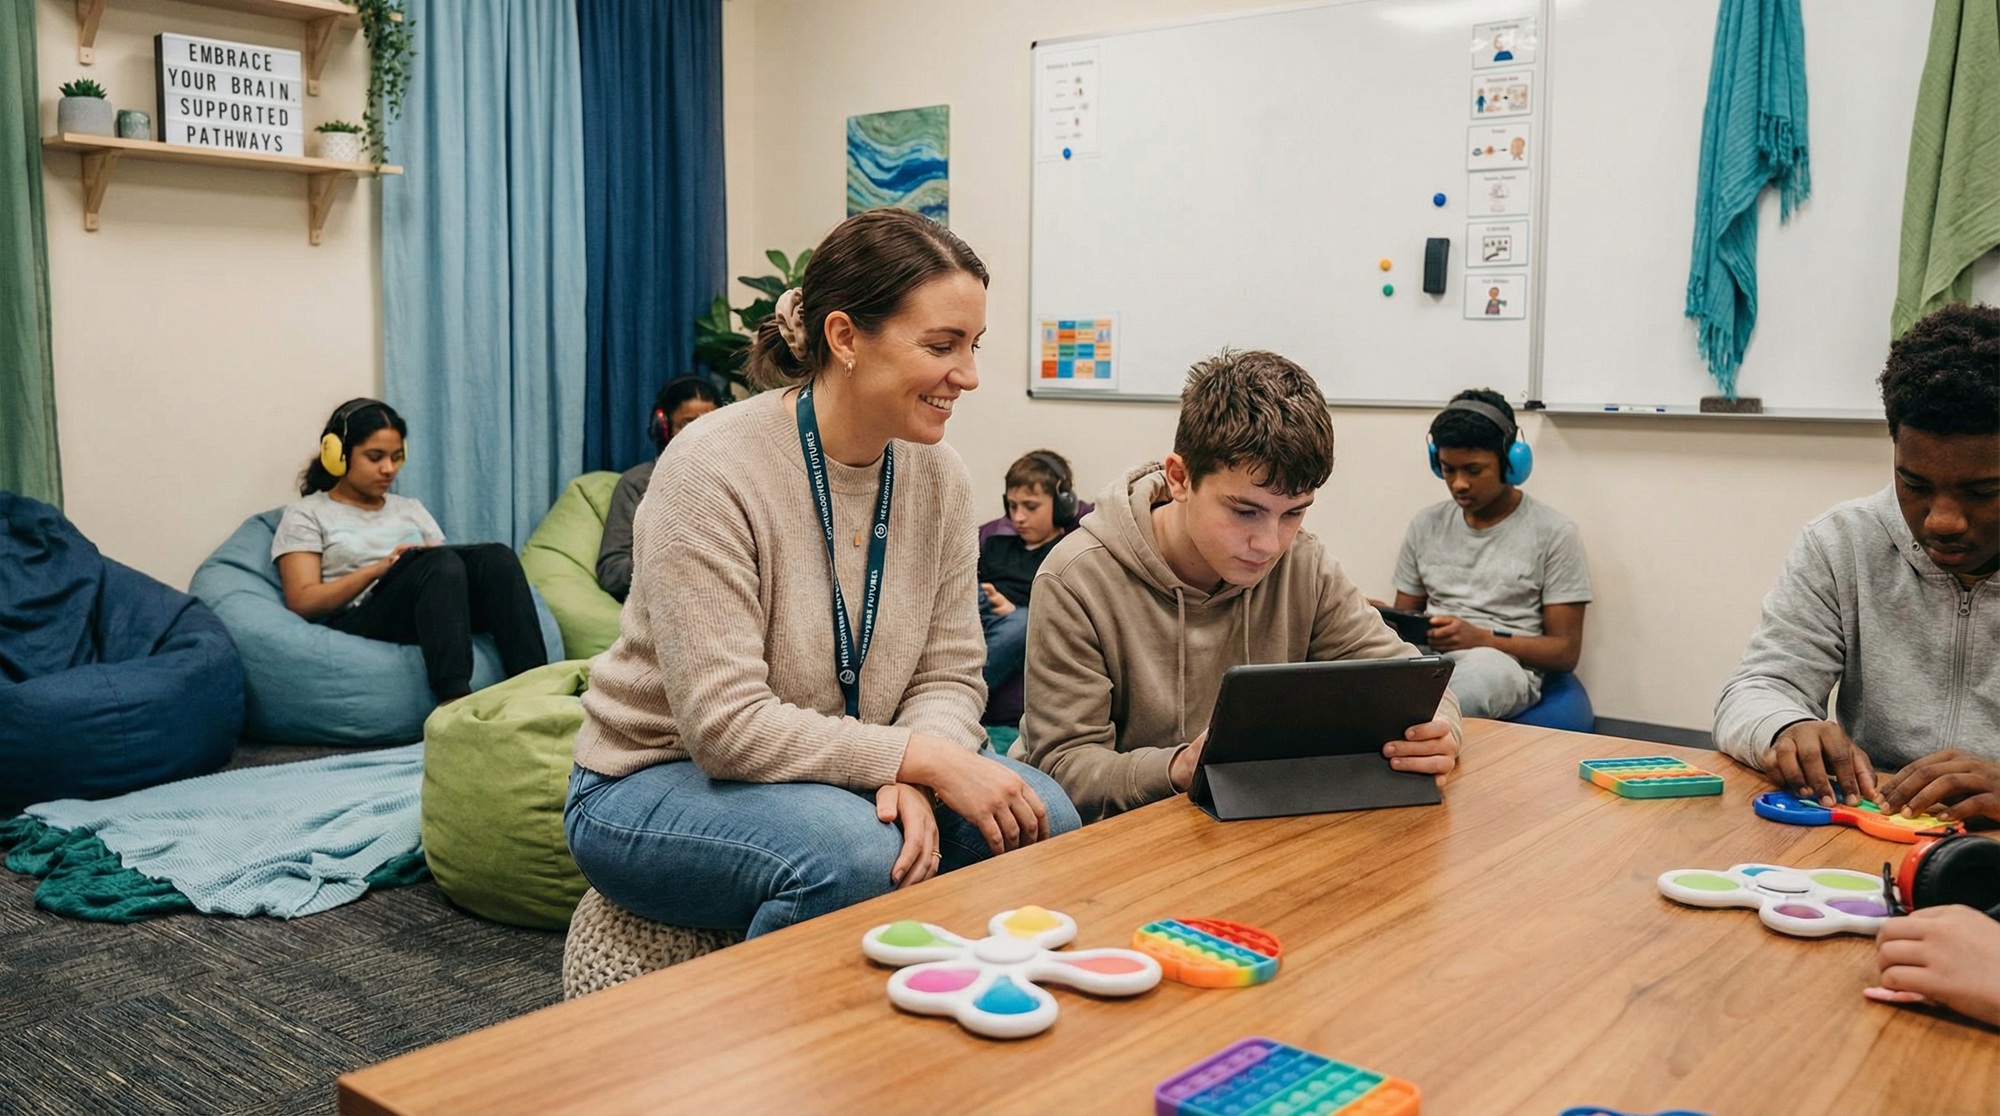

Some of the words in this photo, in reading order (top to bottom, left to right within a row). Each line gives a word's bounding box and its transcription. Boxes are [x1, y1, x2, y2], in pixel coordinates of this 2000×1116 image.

[189, 43, 272, 71] EMBRACE
[168, 68, 216, 91] YOUR
[231, 76, 296, 102] BRAIN.
[180, 97, 289, 126] SUPPORTED
[187, 125, 283, 152] PATHWAYS
